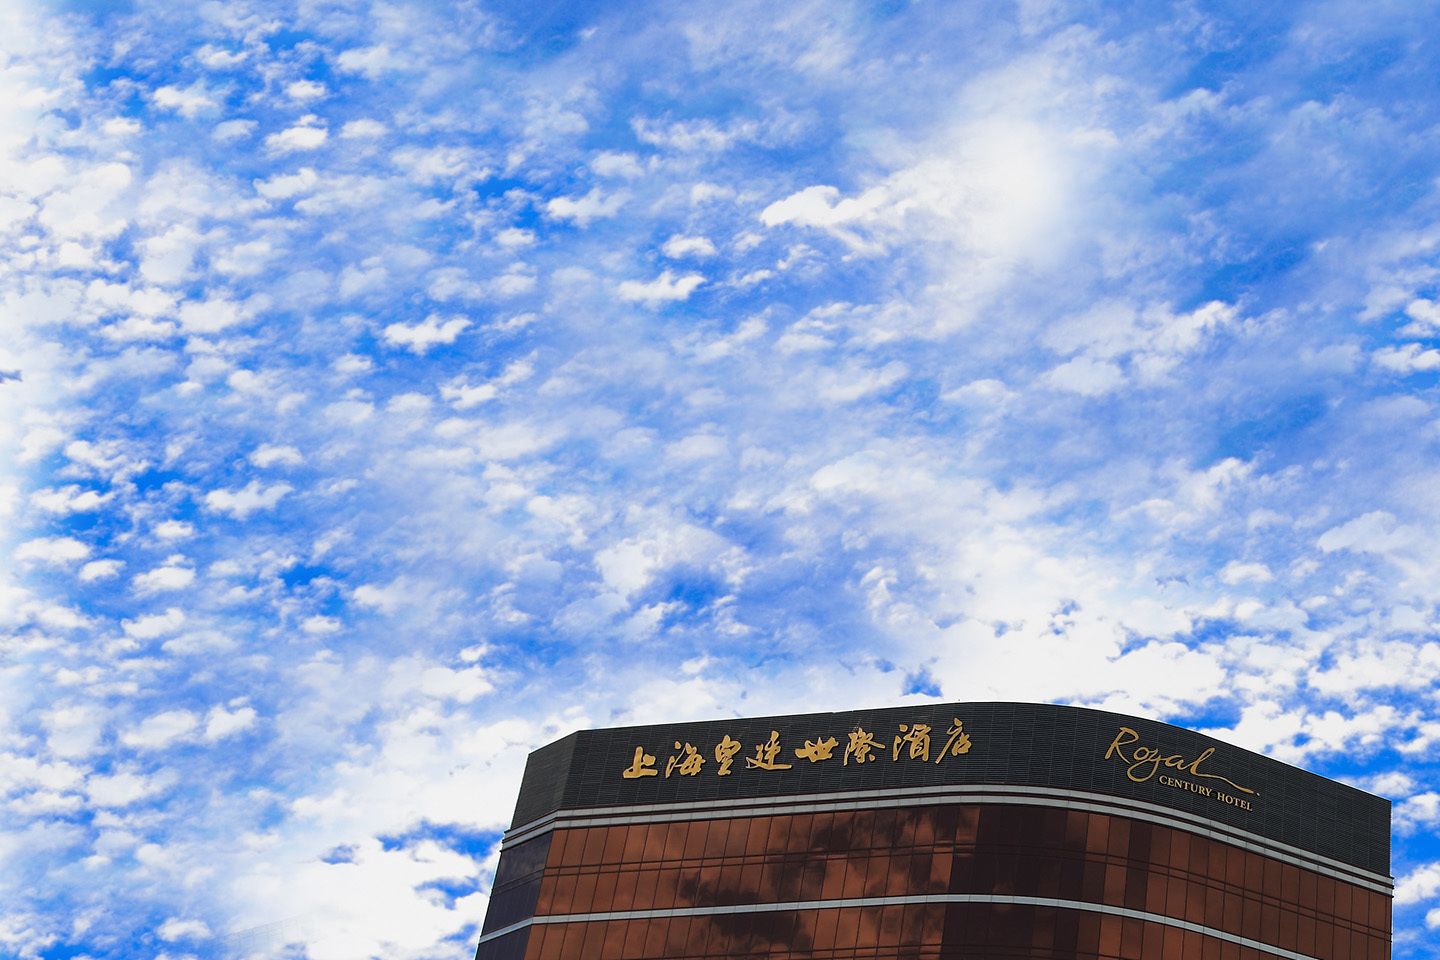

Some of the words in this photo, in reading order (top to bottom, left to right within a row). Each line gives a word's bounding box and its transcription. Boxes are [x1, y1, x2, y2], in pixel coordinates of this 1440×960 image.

[1104, 726, 1260, 796] Royal
[1158, 774, 1213, 797] CENTURY
[1216, 791, 1253, 812] HOTEL
